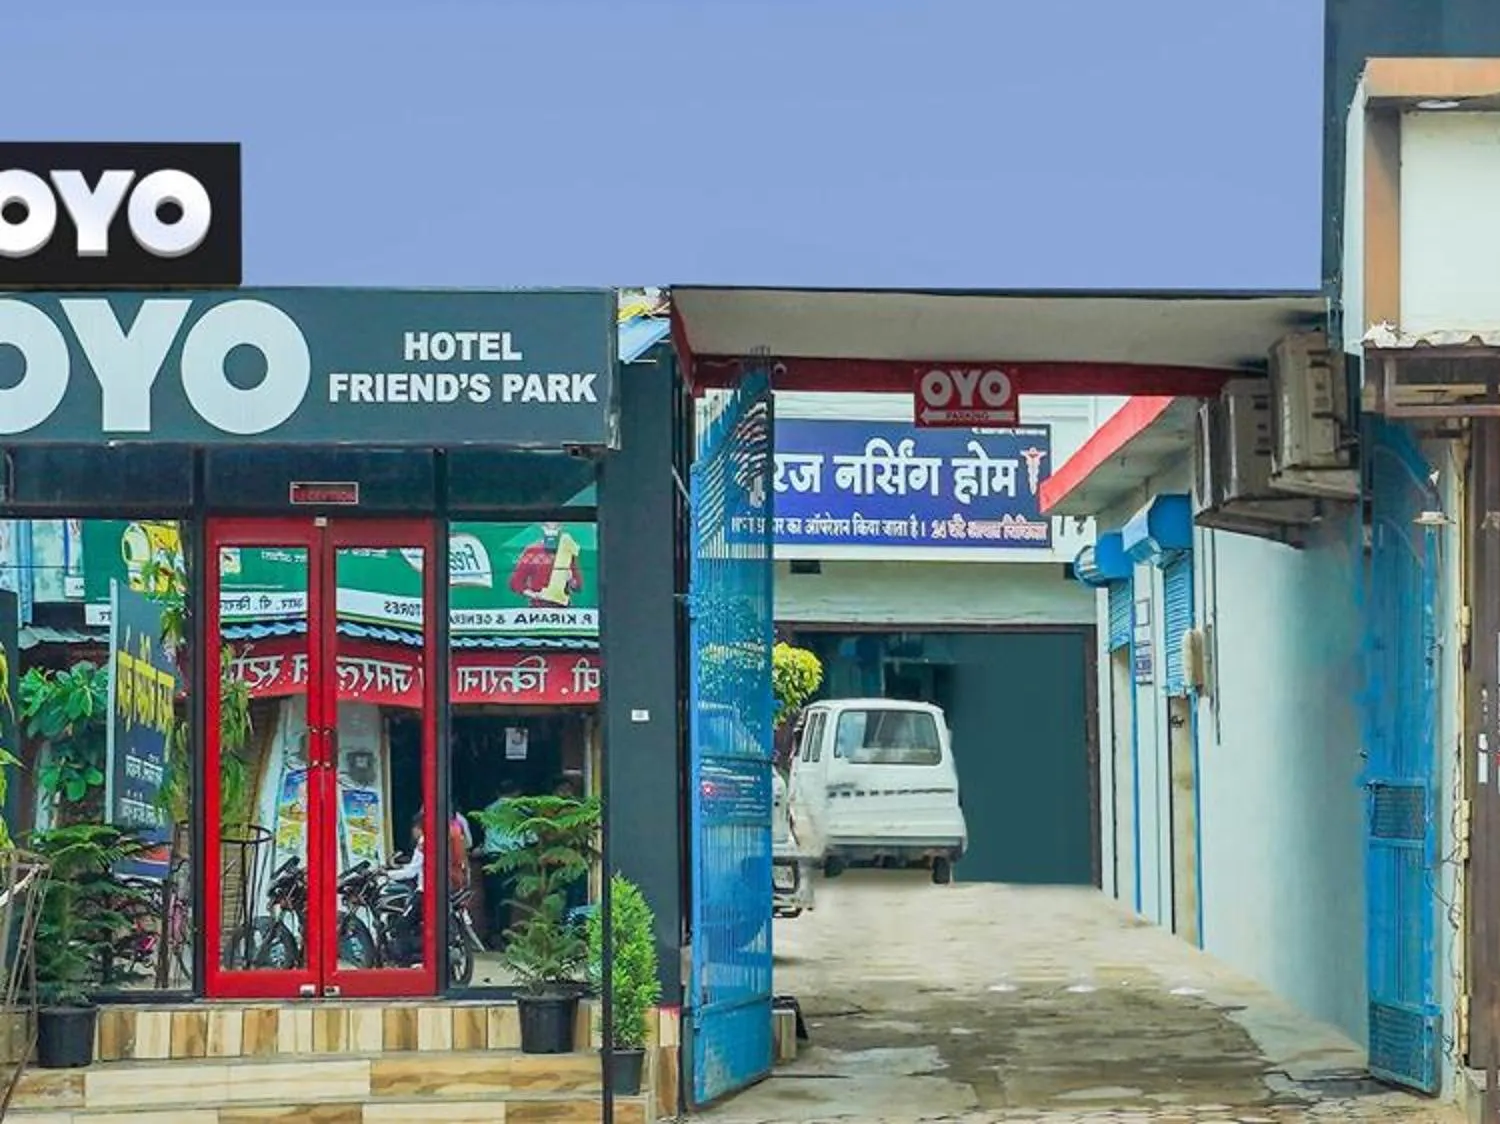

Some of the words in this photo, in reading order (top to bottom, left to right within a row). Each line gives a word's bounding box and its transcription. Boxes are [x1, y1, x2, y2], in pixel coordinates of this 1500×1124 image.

[0, 168, 212, 258] OYO
[403, 331, 523, 362] HOTEL
[328, 373, 491, 403] FRIEND'S
[502, 373, 598, 403] PARK
[920, 370, 1011, 408] OYO
[833, 437, 942, 496] नर्सिंग
[951, 440, 1019, 505] होम
